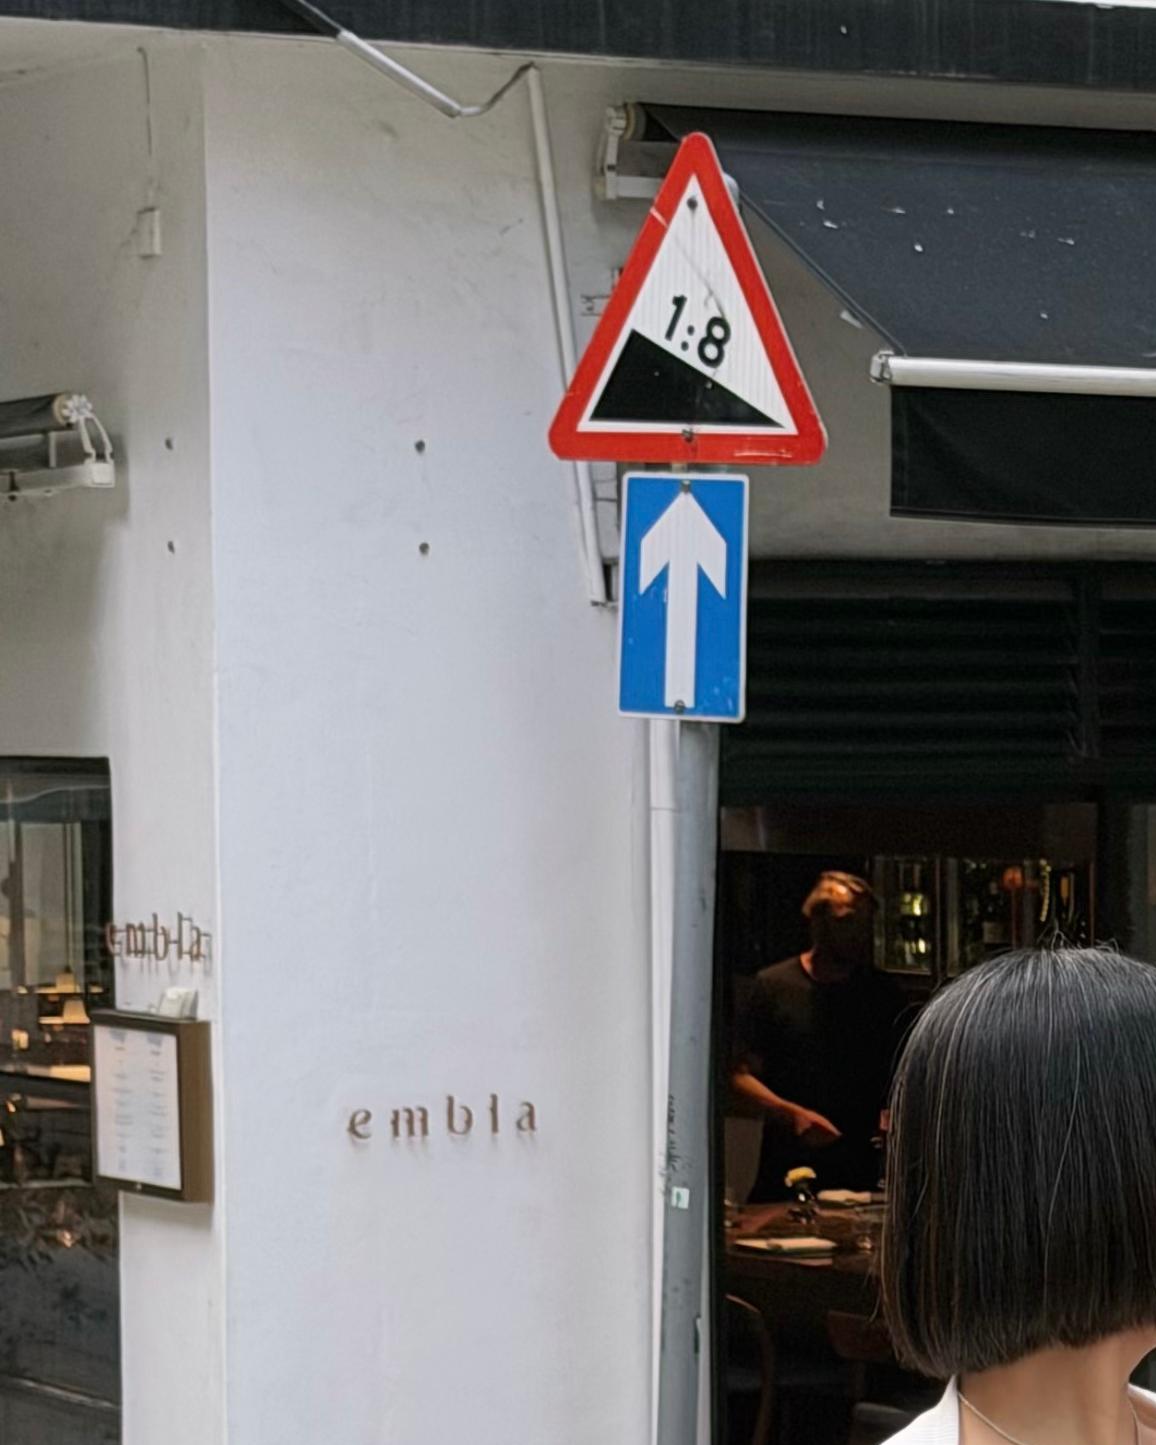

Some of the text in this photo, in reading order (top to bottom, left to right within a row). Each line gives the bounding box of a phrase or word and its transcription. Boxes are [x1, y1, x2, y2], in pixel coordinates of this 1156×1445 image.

[664, 294, 731, 369] 1:8
[105, 912, 202, 961] embla
[347, 1093, 537, 1139] embla
